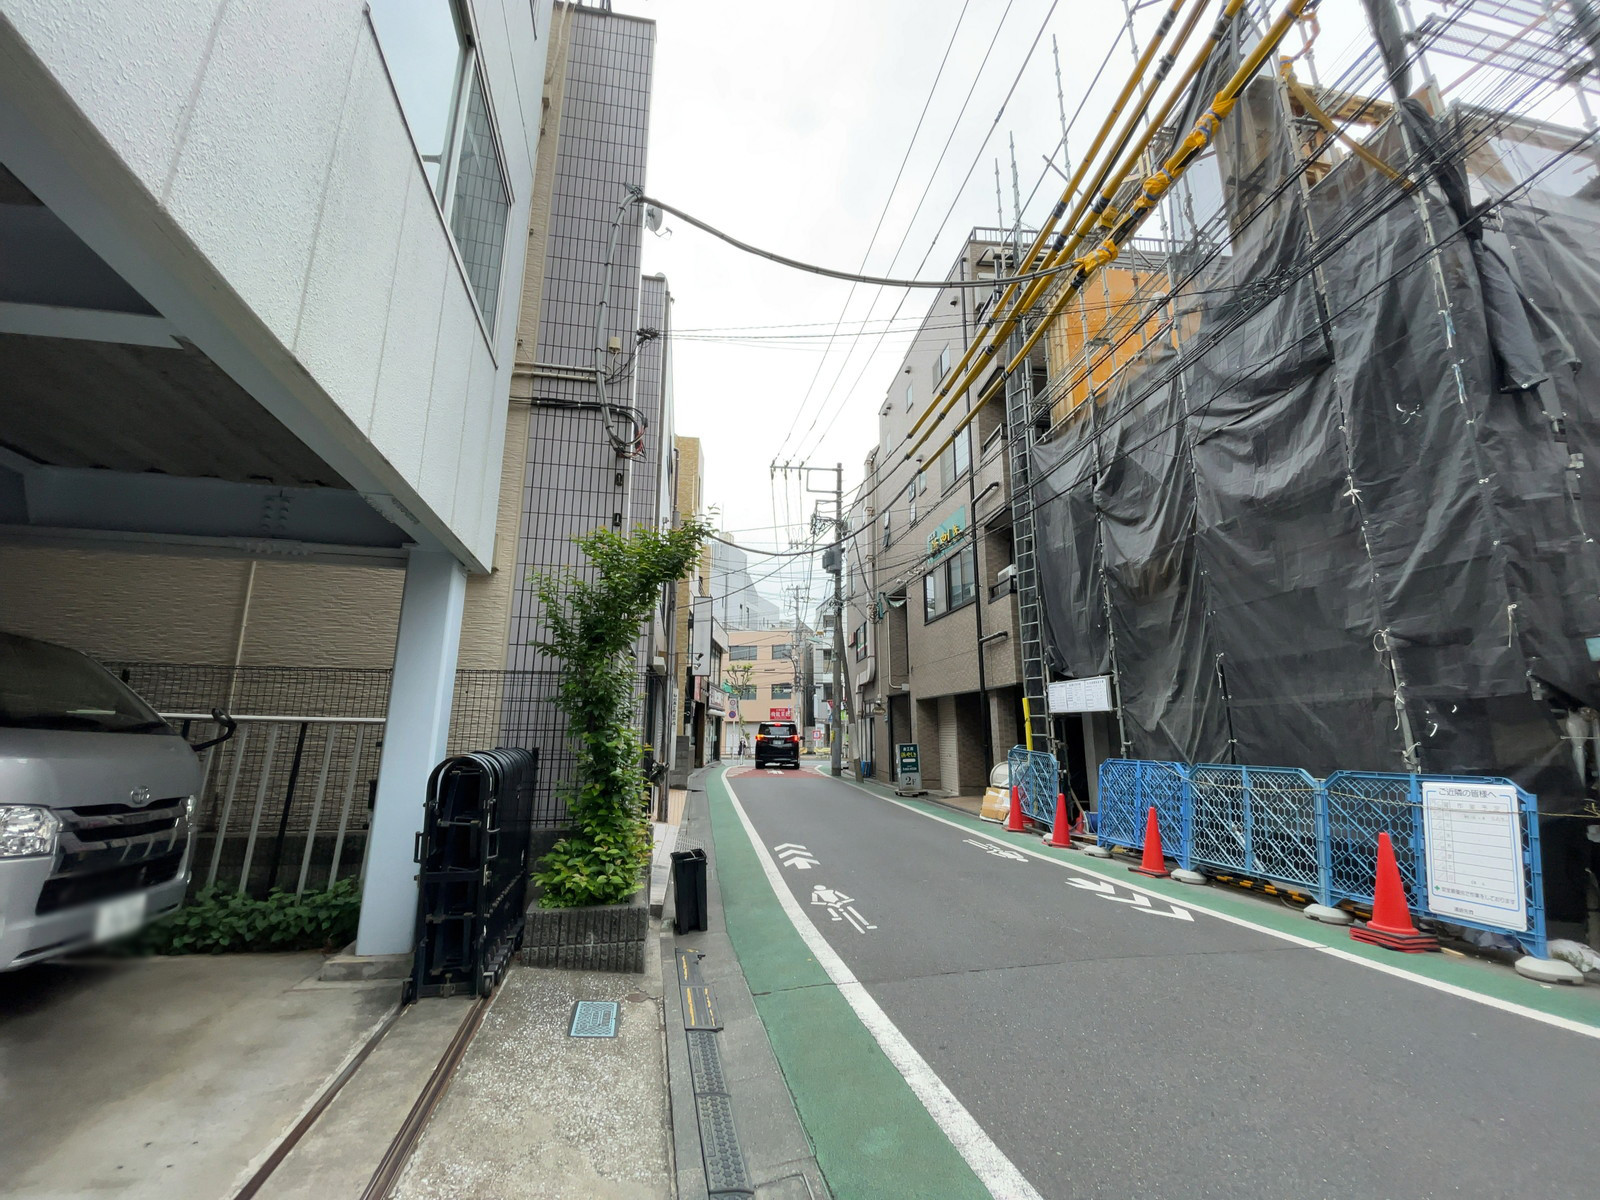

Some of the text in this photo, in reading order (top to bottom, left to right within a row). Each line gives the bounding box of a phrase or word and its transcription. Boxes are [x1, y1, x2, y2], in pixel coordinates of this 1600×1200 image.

[905, 776, 917, 786] 2F
[1439, 787, 1497, 798] ご近隣の皆様へ
